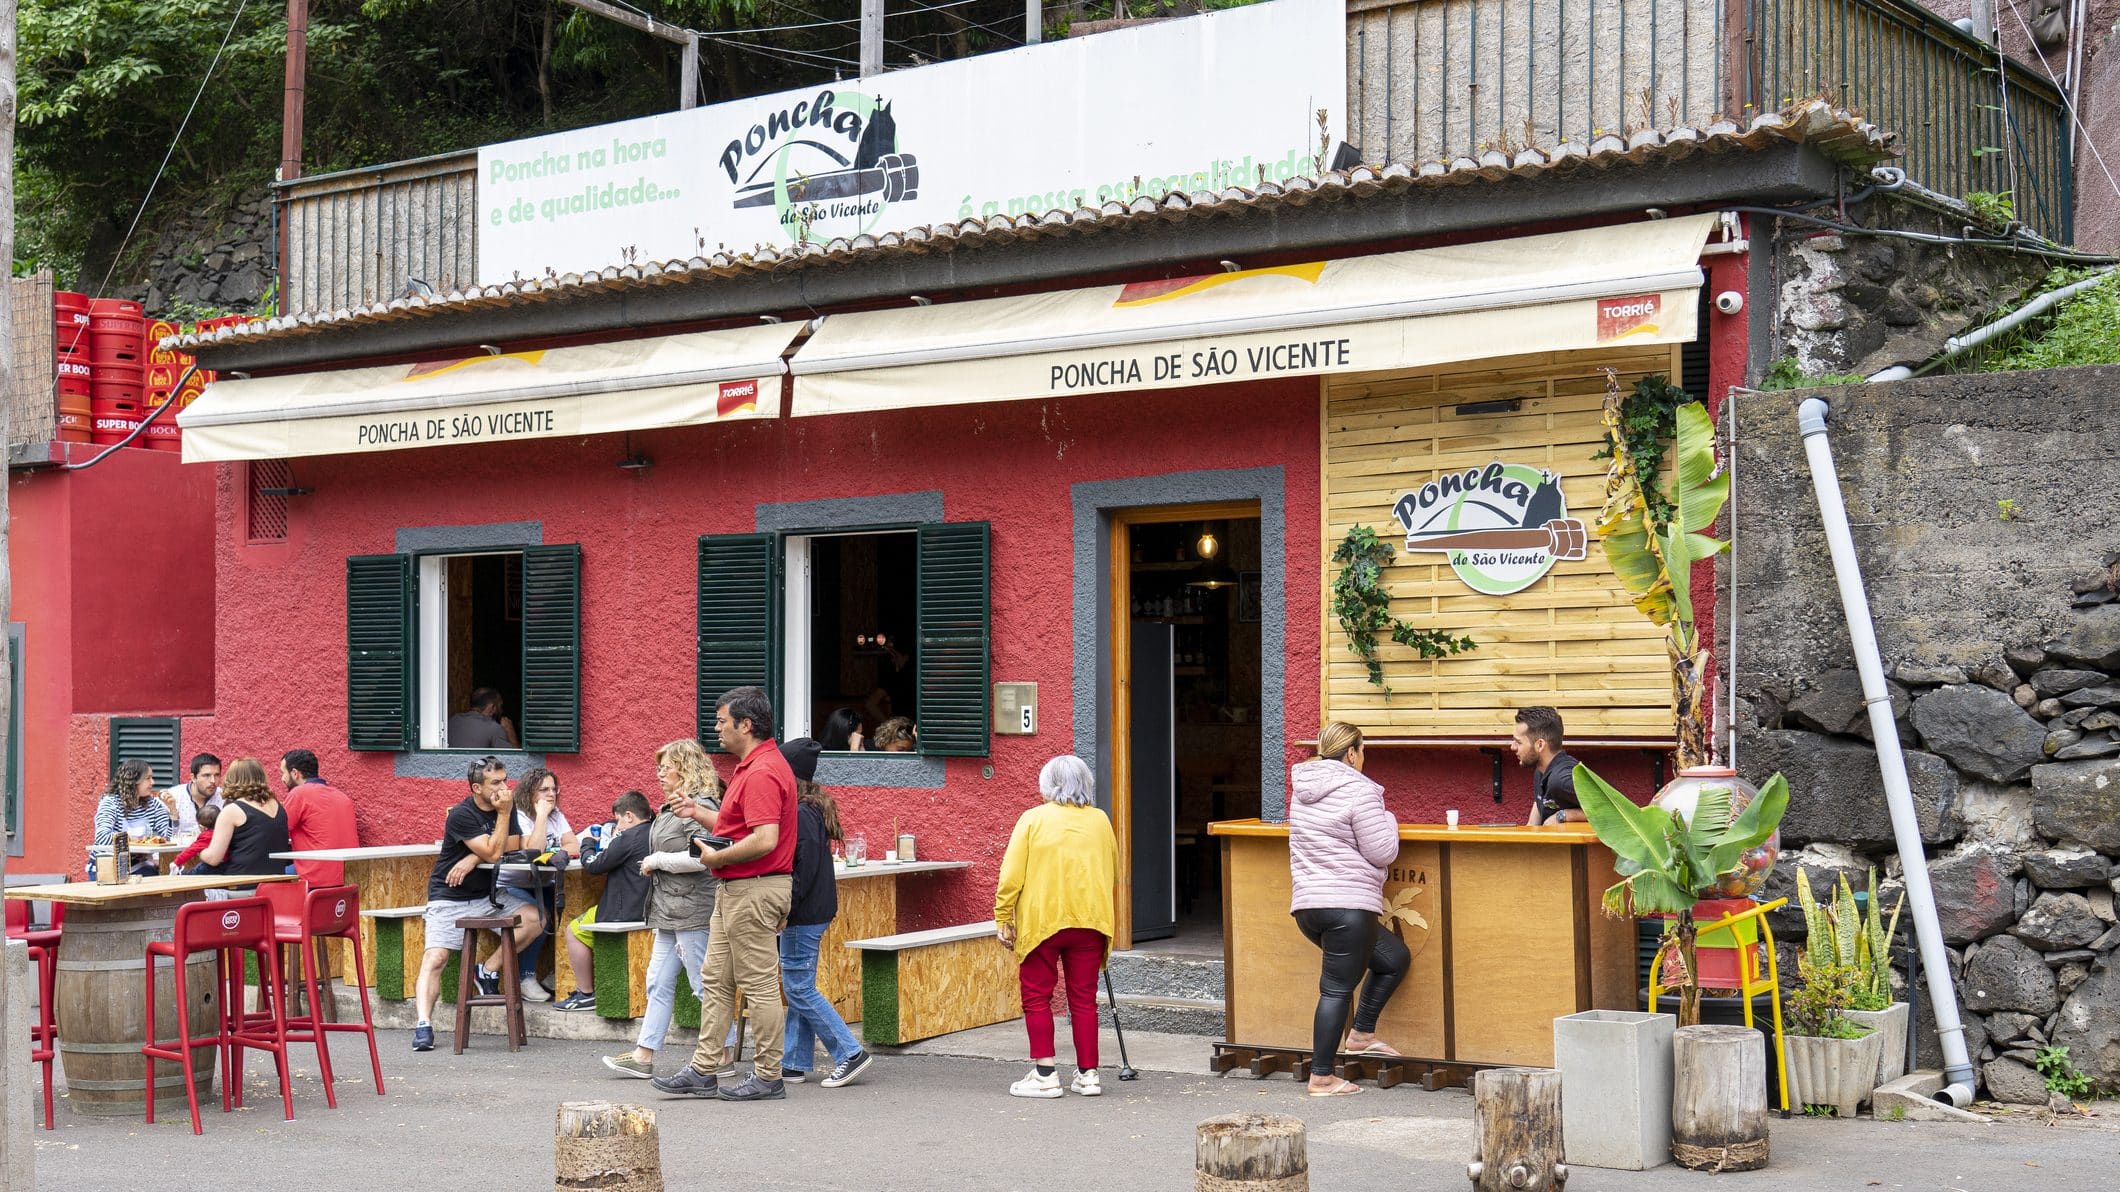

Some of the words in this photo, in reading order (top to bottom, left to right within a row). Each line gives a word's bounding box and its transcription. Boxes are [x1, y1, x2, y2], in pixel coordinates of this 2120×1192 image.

[489, 149, 571, 184] Poncha
[577, 148, 606, 171] na
[613, 136, 667, 165] hora
[490, 207, 502, 226] e
[509, 194, 535, 224] de
[541, 177, 681, 222] qualidade...
[831, 200, 879, 218] Vicente
[982, 201, 999, 218] a
[1008, 188, 1087, 218] nossa
[1050, 359, 1142, 390] PONCHA
[1154, 354, 1182, 381] DE
[1191, 347, 1238, 378] SÃO
[1247, 339, 1351, 373] VICENTE
[97, 419, 127, 429] SUPER
[358, 420, 420, 445] PONCHA
[427, 419, 445, 440] DE
[451, 413, 482, 438] SÃO
[488, 410, 554, 435] VICENTE
[1452, 553, 1468, 566] de
[1472, 553, 1497, 566] São
[1500, 552, 1545, 565] Vicente
[1023, 709, 1031, 728] 5
[1387, 869, 1426, 885] EIRA
